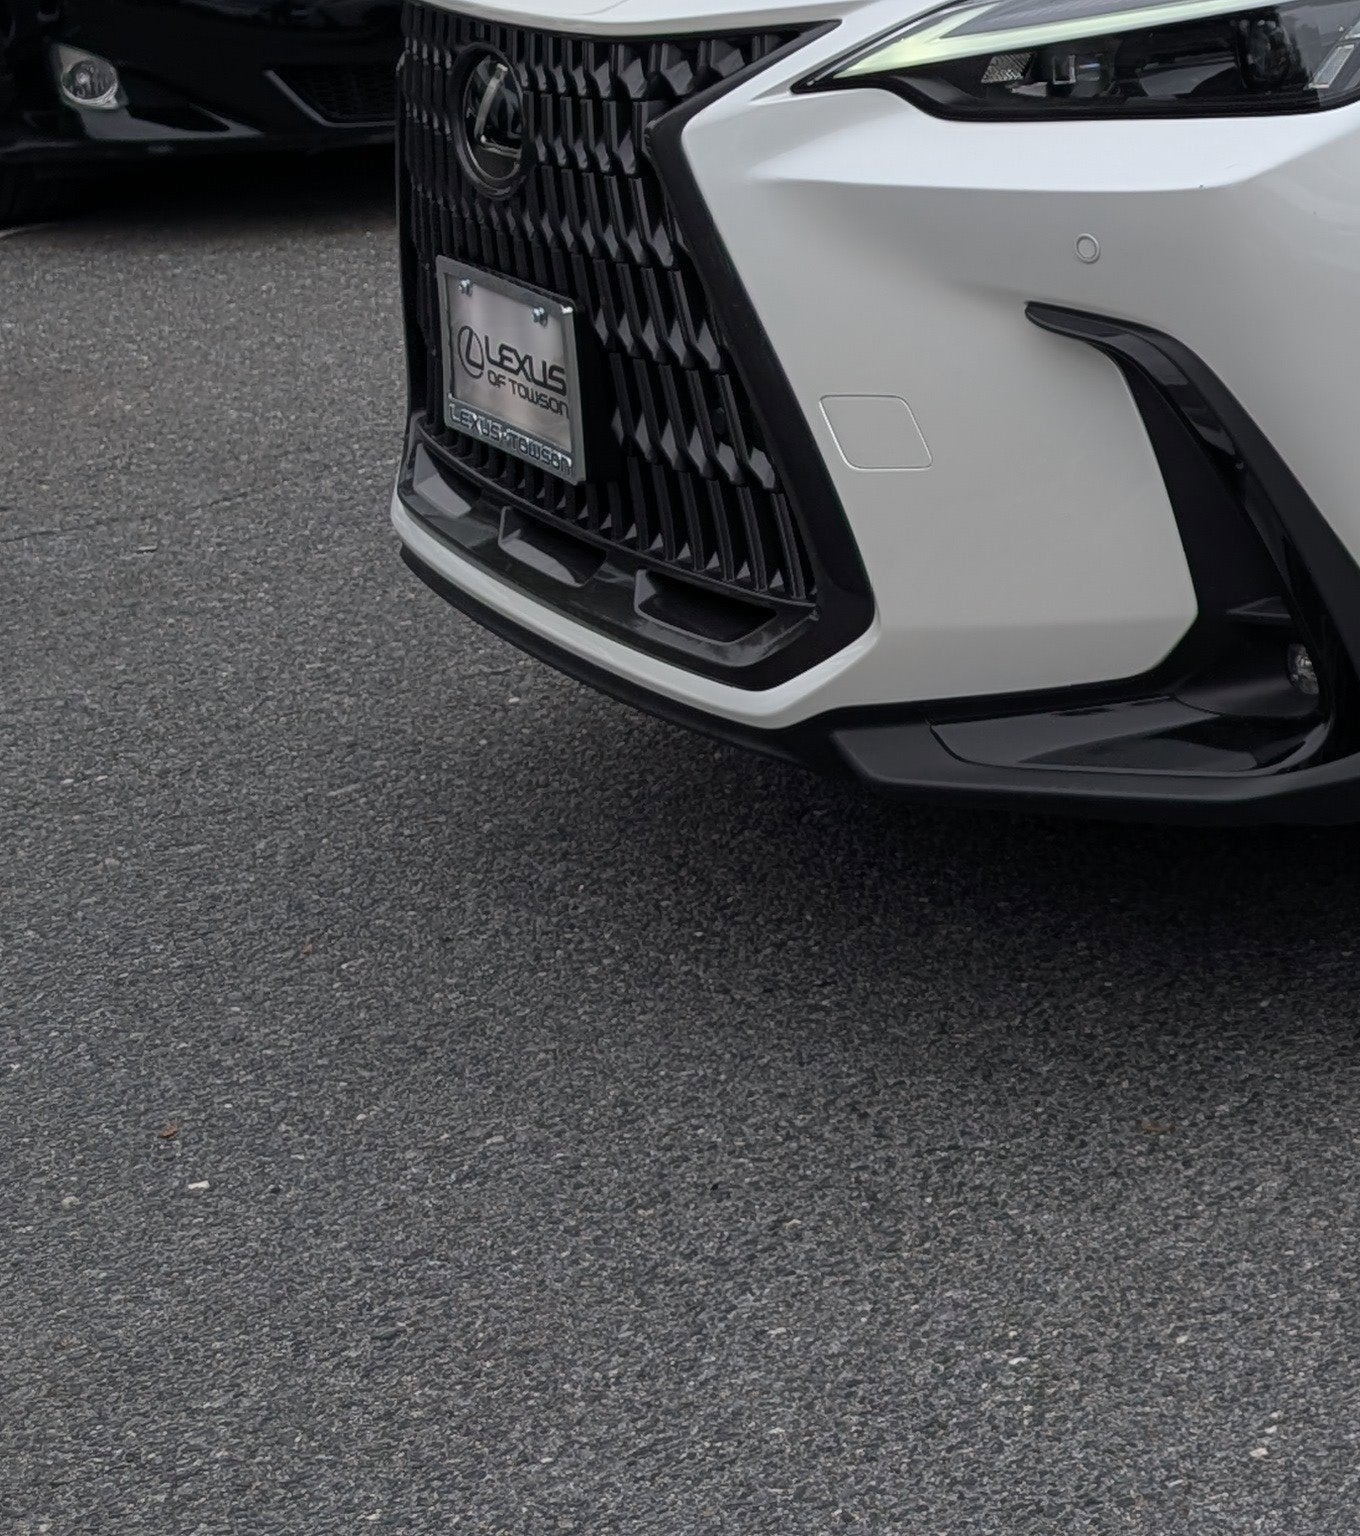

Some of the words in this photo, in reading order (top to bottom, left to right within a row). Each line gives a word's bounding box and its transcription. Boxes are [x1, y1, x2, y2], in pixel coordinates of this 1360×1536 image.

[484, 334, 567, 397] LEXUS
[487, 369, 506, 388] OF
[508, 379, 570, 420] TOWSON
[449, 403, 502, 442] LEXUS
